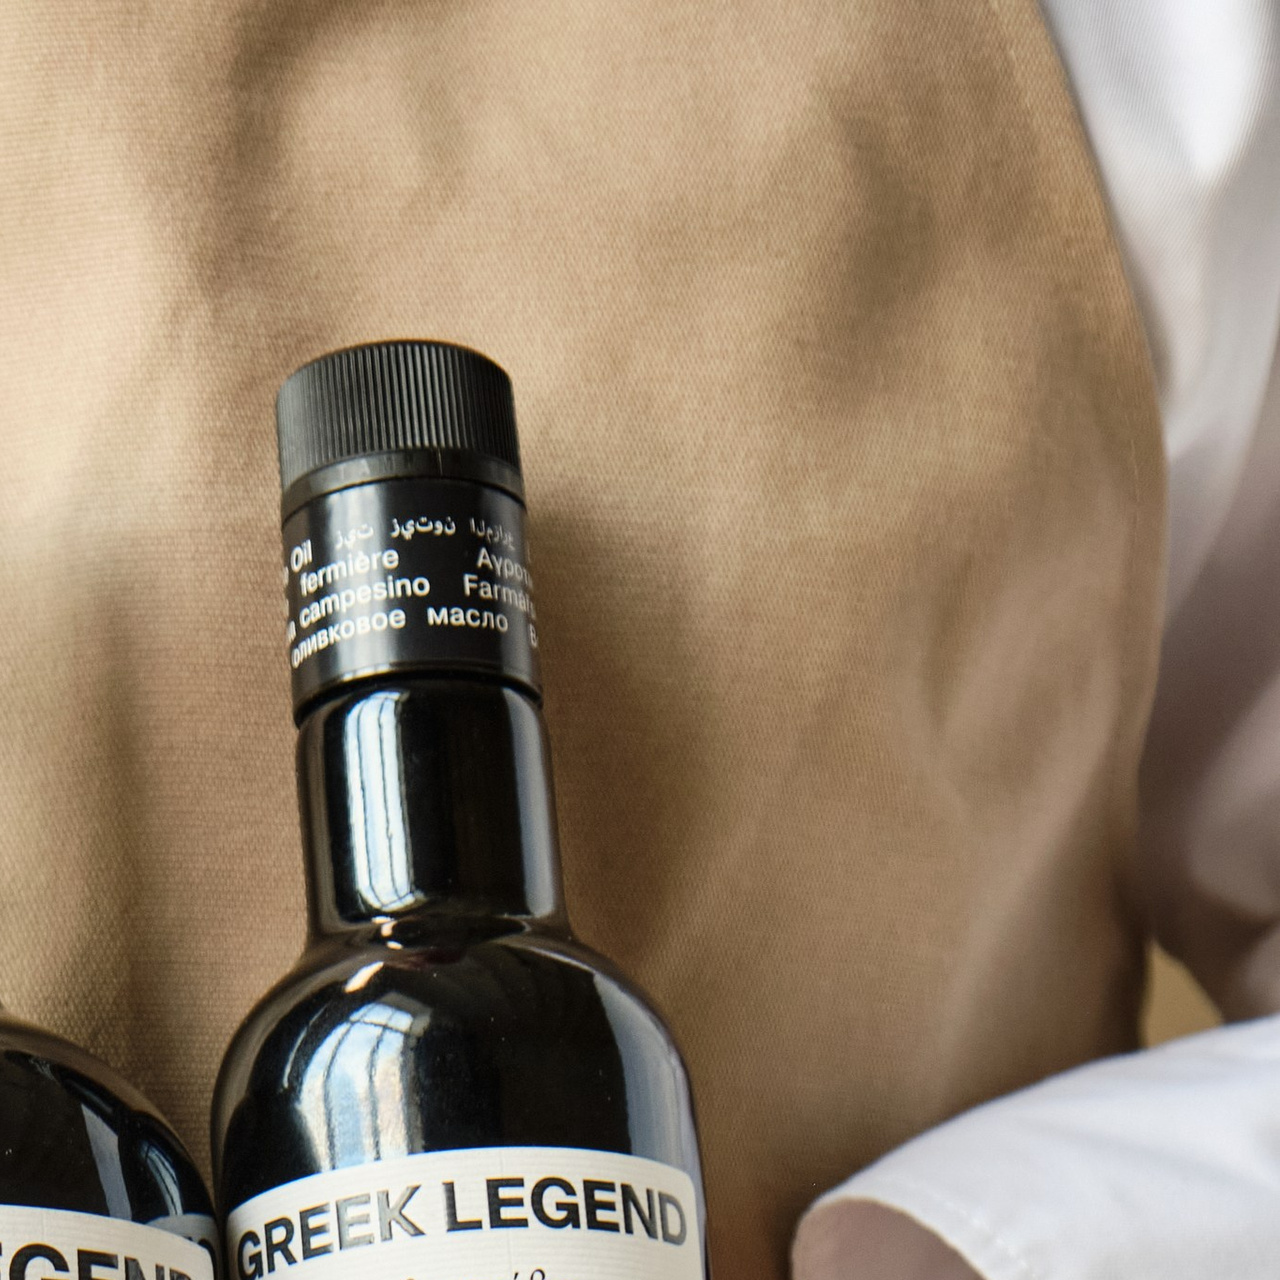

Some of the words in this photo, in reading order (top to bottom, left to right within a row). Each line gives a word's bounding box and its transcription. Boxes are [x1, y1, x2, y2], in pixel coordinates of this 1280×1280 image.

[290, 539, 313, 573] Oil
[300, 546, 400, 597] fermière
[299, 574, 431, 630] campesino
[291, 607, 407, 669] оливковое
[427, 605, 509, 632] масло
[444, 1176, 688, 1247] LEGEND
